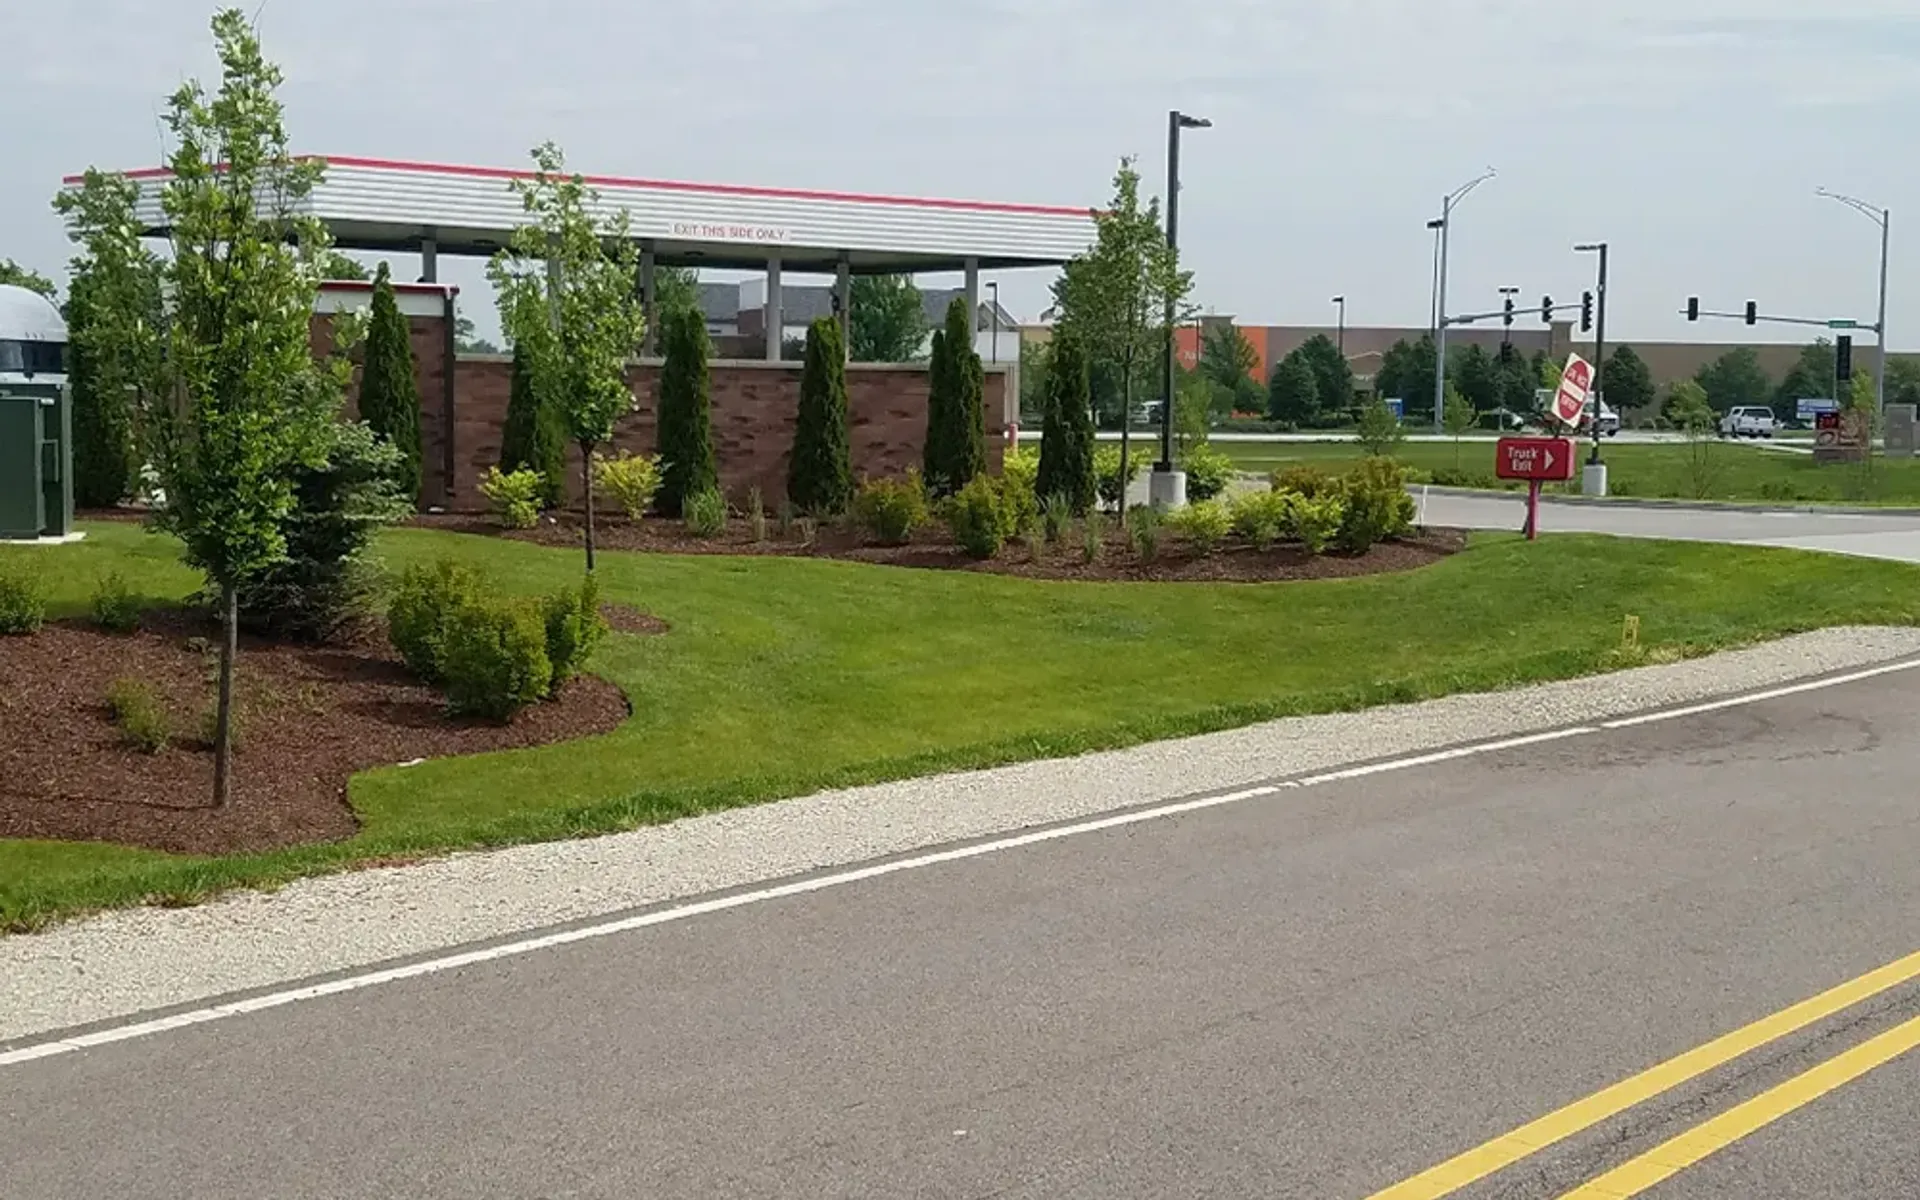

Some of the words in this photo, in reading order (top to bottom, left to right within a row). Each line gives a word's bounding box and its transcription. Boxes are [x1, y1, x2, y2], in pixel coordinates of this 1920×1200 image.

[673, 222, 698, 235] EXIT
[701, 225, 725, 237] THIS
[729, 226, 752, 239] SIDE
[757, 228, 785, 240] ONLY
[1508, 446, 1538, 459] Truck
[1512, 459, 1532, 472] Exit
